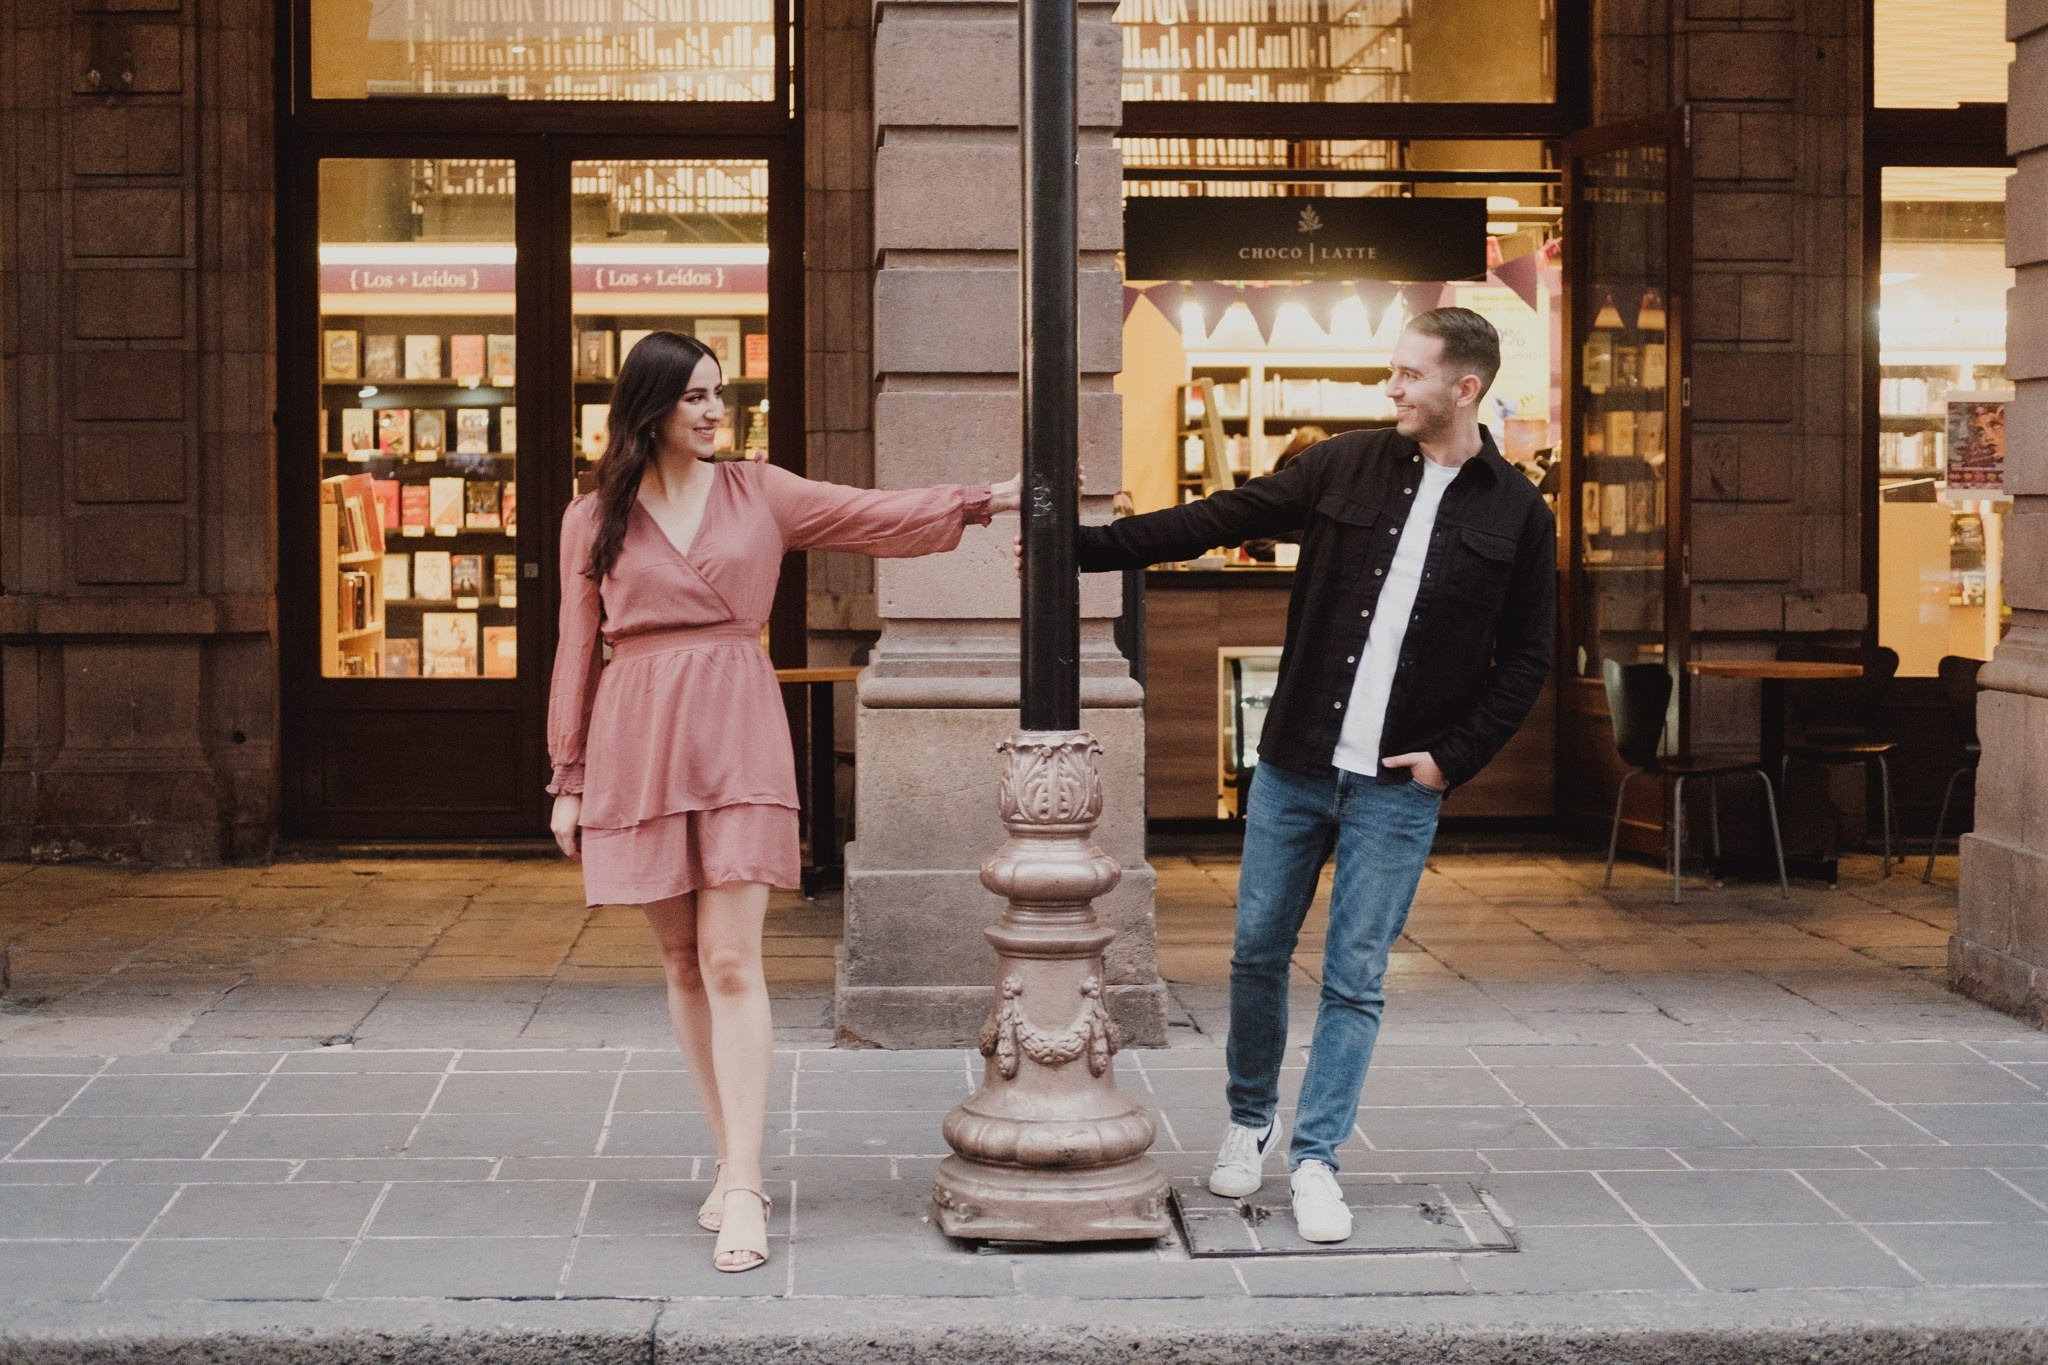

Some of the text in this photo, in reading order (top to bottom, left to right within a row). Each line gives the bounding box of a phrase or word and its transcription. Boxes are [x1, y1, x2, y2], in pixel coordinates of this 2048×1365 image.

[1238, 247, 1377, 260] CHOCO LATTE
[363, 271, 393, 288] Los
[411, 270, 467, 288] Leídos
[608, 270, 639, 287] Los
[656, 268, 712, 286] Leídos
